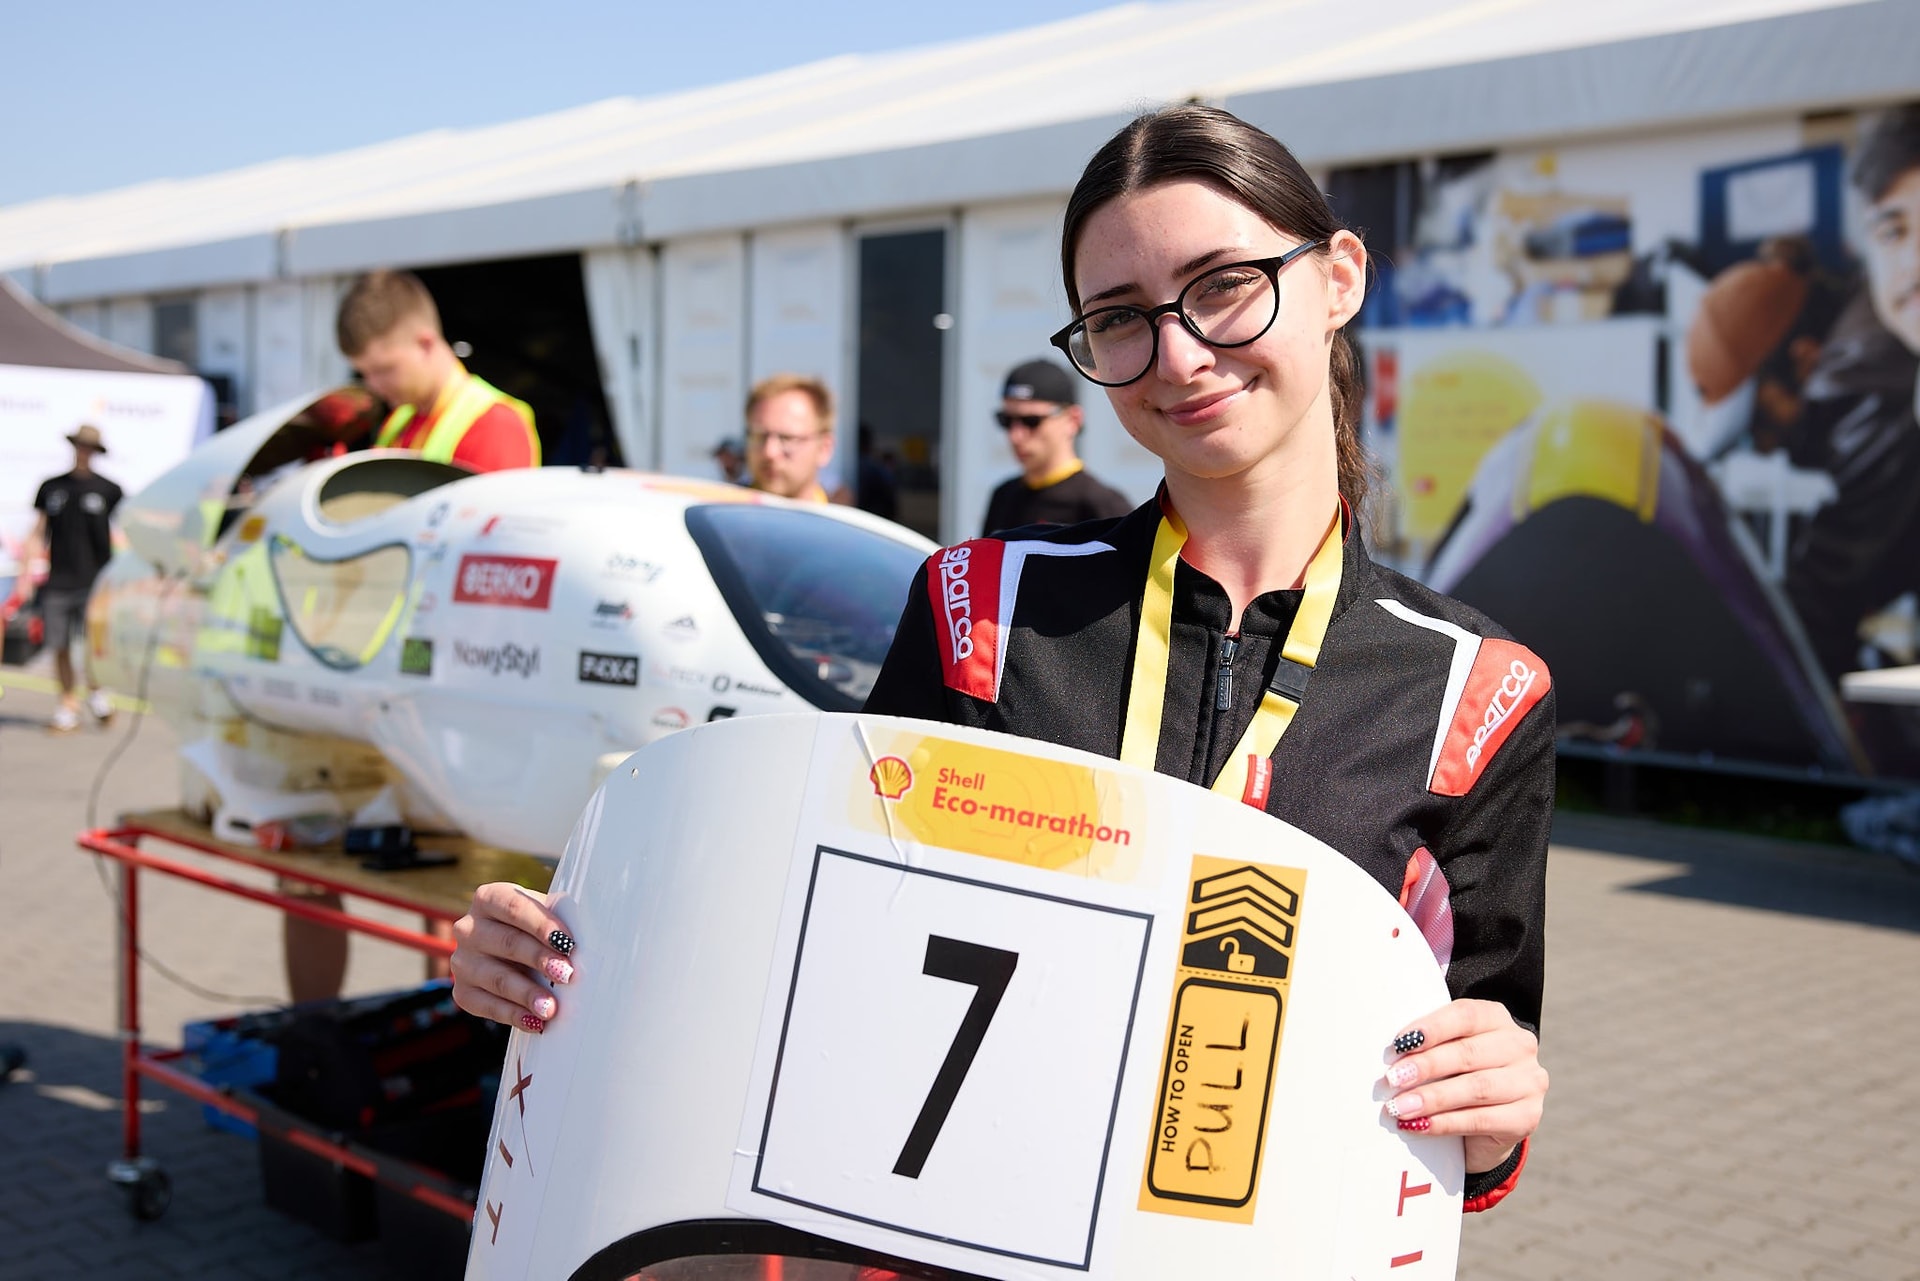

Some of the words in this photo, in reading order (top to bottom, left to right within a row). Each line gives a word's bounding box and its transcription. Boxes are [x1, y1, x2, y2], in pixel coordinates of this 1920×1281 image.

[939, 546, 974, 664] sparco
[1466, 660, 1536, 773] sparco
[932, 787, 1131, 846] Eco-marathon
[937, 768, 985, 791] Shell
[892, 934, 1019, 1179] 7
[1175, 1024, 1194, 1073] OPEN
[1170, 1079, 1185, 1100] TO
[1186, 1013, 1249, 1174] PULL
[1161, 1106, 1181, 1152] HOW
[1391, 1170, 1431, 1268] IT
